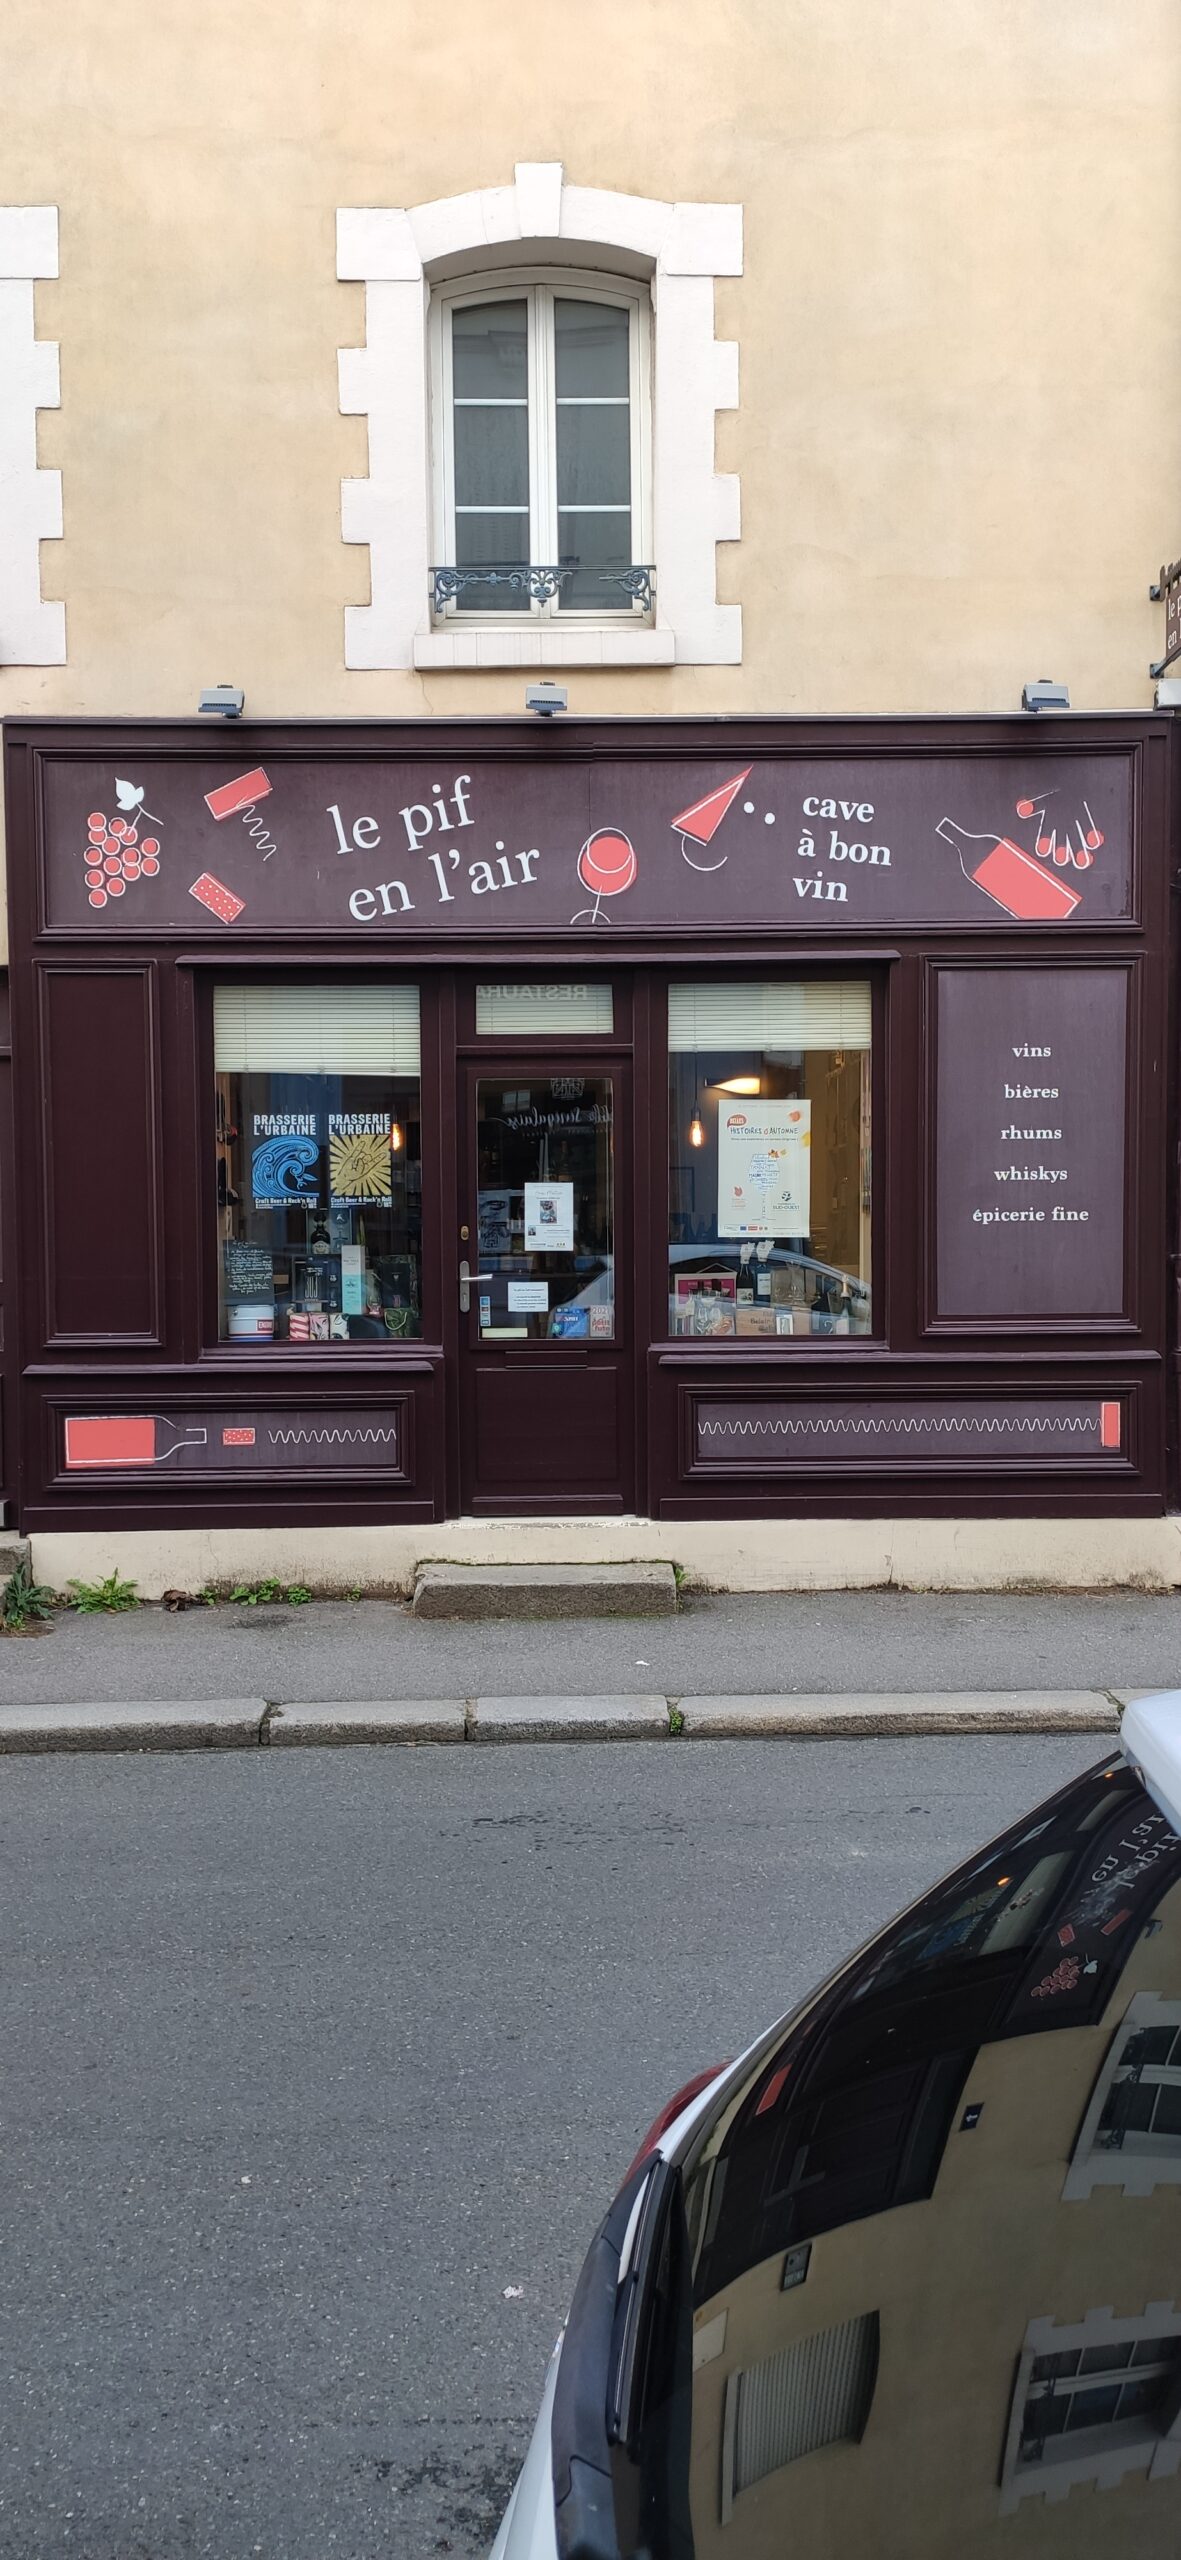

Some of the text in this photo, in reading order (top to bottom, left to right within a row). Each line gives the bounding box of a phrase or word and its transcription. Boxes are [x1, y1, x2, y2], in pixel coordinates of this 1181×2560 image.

[1168, 598, 1176, 621] le
[1168, 631, 1177, 650] en
[326, 774, 475, 855] le pif
[802, 796, 875, 823] cave
[797, 828, 892, 866] à bon
[792, 871, 849, 902] vin
[349, 879, 416, 921] en
[1012, 1043, 1052, 1058] vins
[1004, 1084, 1060, 1099] bières
[253, 1114, 317, 1125] BRASSERIE
[328, 1113, 391, 1124] BRASSERIE
[253, 1125, 317, 1136] L'URBAINE
[328, 1124, 391, 1135] L'URBAINE
[1001, 1125, 1063, 1140] rhums
[994, 1166, 1068, 1183] whiskys
[972, 1206, 1089, 1225] épicerie fine
